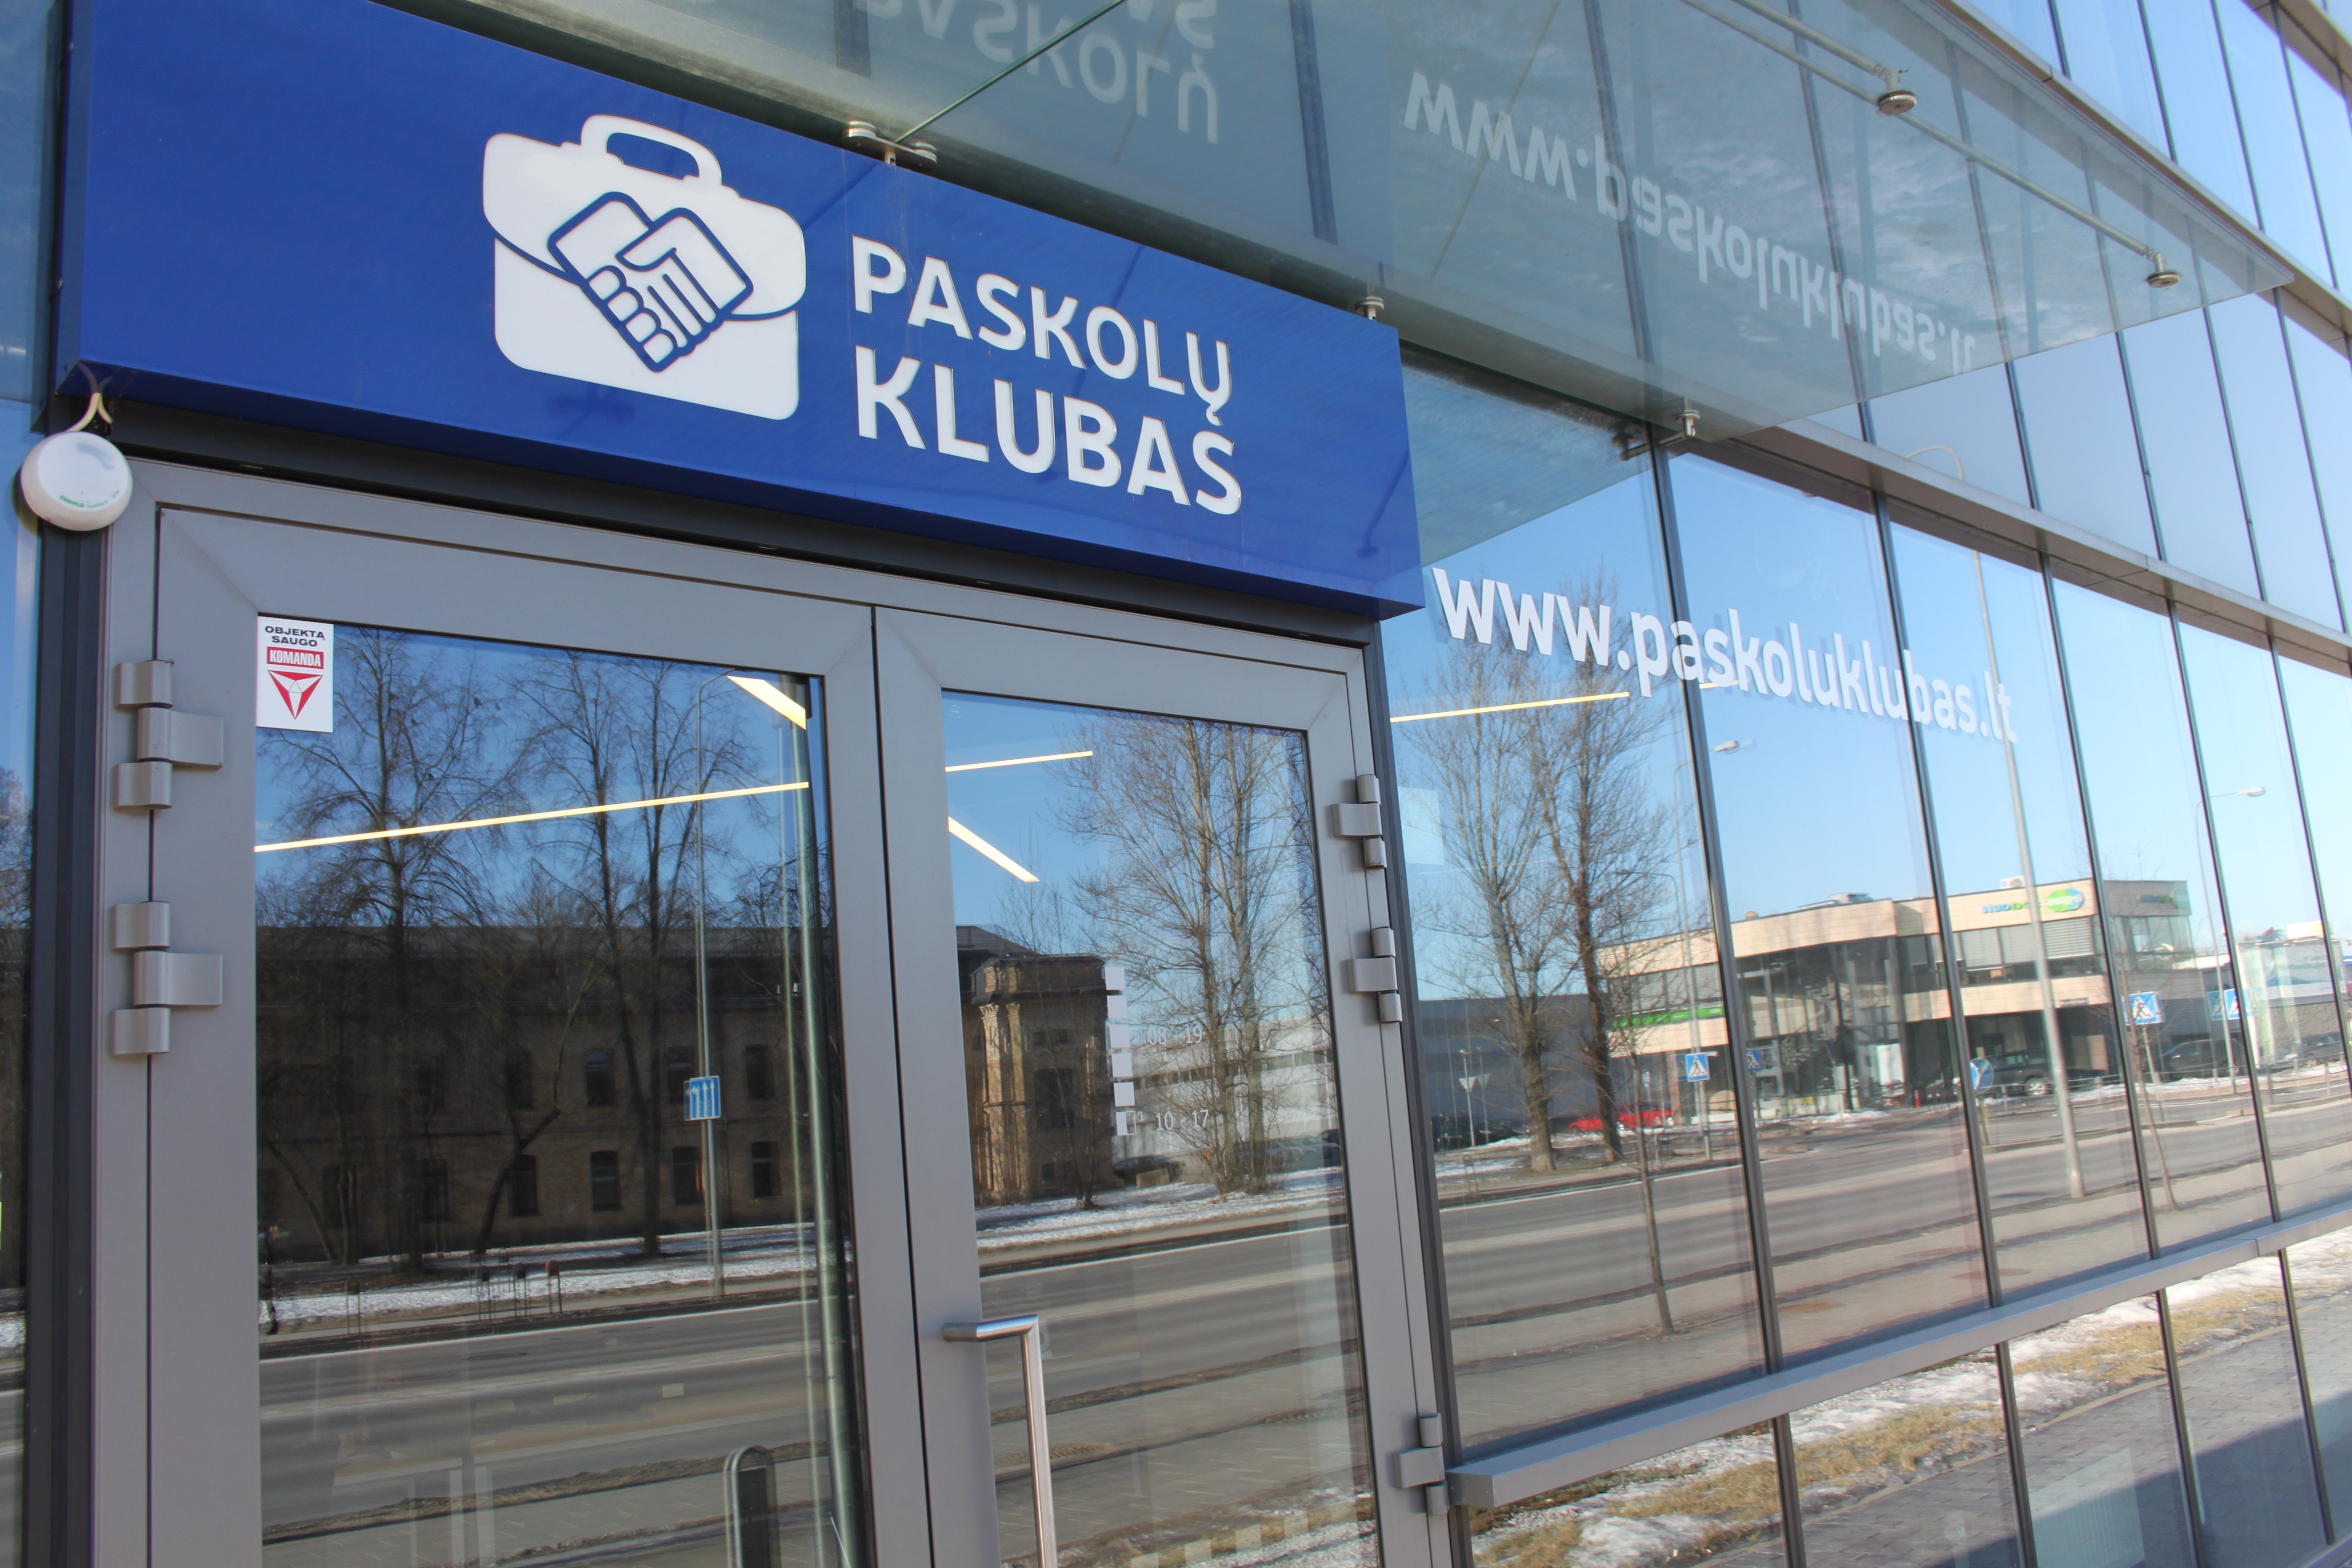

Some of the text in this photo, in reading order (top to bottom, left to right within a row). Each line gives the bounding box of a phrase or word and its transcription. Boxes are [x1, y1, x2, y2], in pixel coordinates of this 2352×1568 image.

[852, 235, 1232, 426] PASKOLŲ
[855, 345, 1242, 515] KLUBAS
[265, 626, 326, 640] OBJEKTĄ
[272, 636, 318, 647] SAUGO
[270, 649, 321, 667] KOMANDA
[1432, 567, 2018, 742] www.paskoluklubas.lt
[1147, 1027, 1167, 1045] 08
[1186, 1026, 1203, 1044] 19
[1156, 1111, 1174, 1131] 10
[1192, 1109, 1209, 1128] 17
